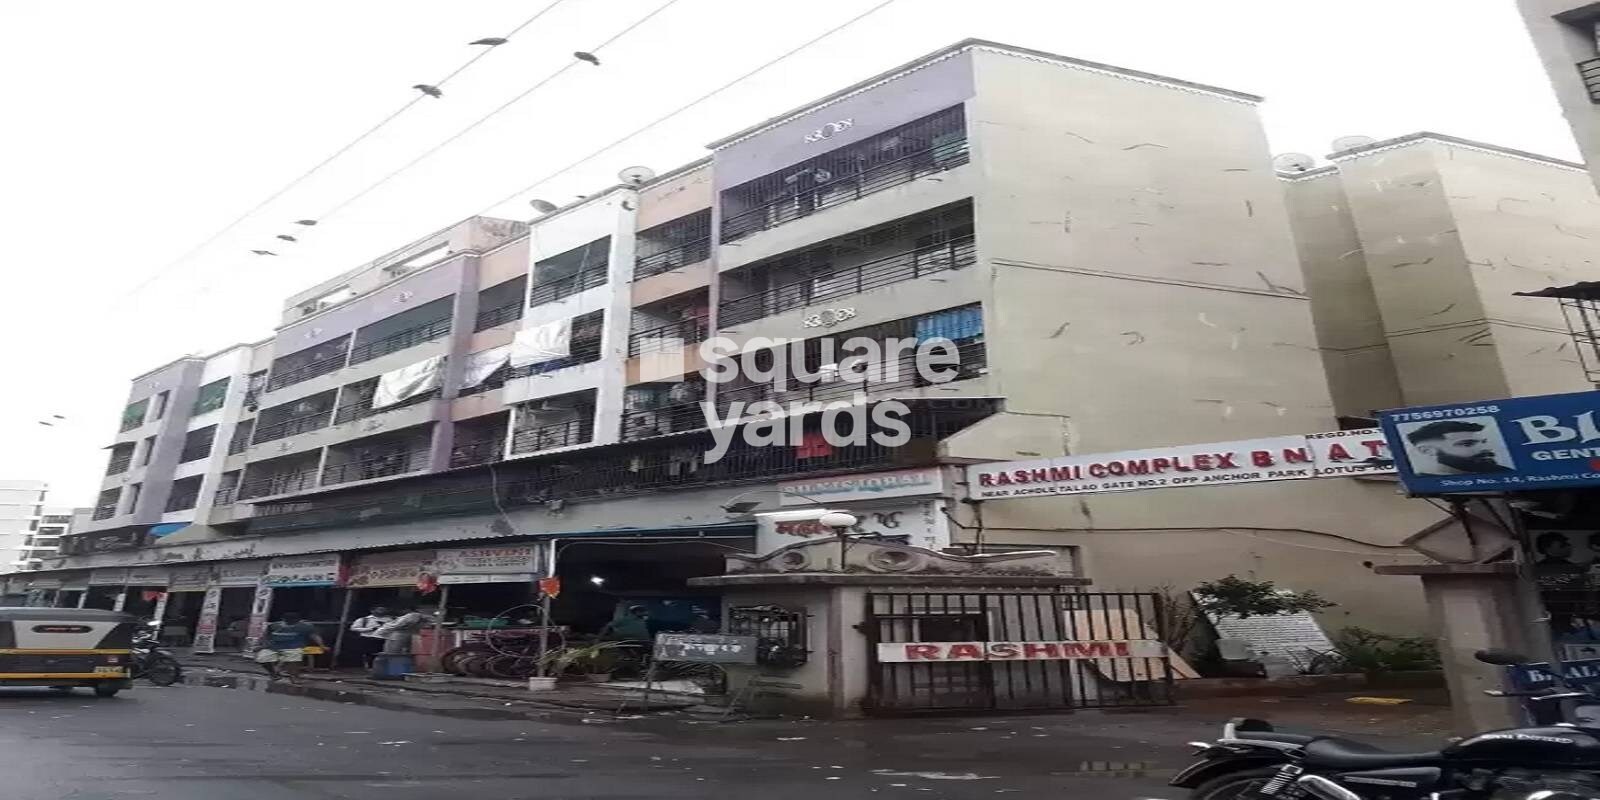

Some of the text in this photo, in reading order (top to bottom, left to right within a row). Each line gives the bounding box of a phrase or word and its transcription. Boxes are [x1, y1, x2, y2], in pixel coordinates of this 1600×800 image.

[1391, 404, 1500, 422] 7756970258
[978, 465, 1085, 488] RASHMI
[1088, 451, 1240, 478] COMPLEX
[1249, 450, 1276, 468] B
[1282, 447, 1313, 464] N
[1328, 442, 1355, 461] A
[981, 489, 1010, 498] NEAR
[1013, 486, 1057, 496] ACHOLE
[1060, 483, 1098, 493] TALAO
[1102, 481, 1134, 490] GATE
[1138, 479, 1167, 487] NO.2
[1172, 476, 1199, 485] OPP
[1203, 471, 1260, 483] ANCHOR
[1267, 468, 1307, 478] PARK
[1440, 477, 1474, 488] Shop
[1527, 473, 1578, 482] Rashmi
[904, 641, 1131, 662] RASHMI
